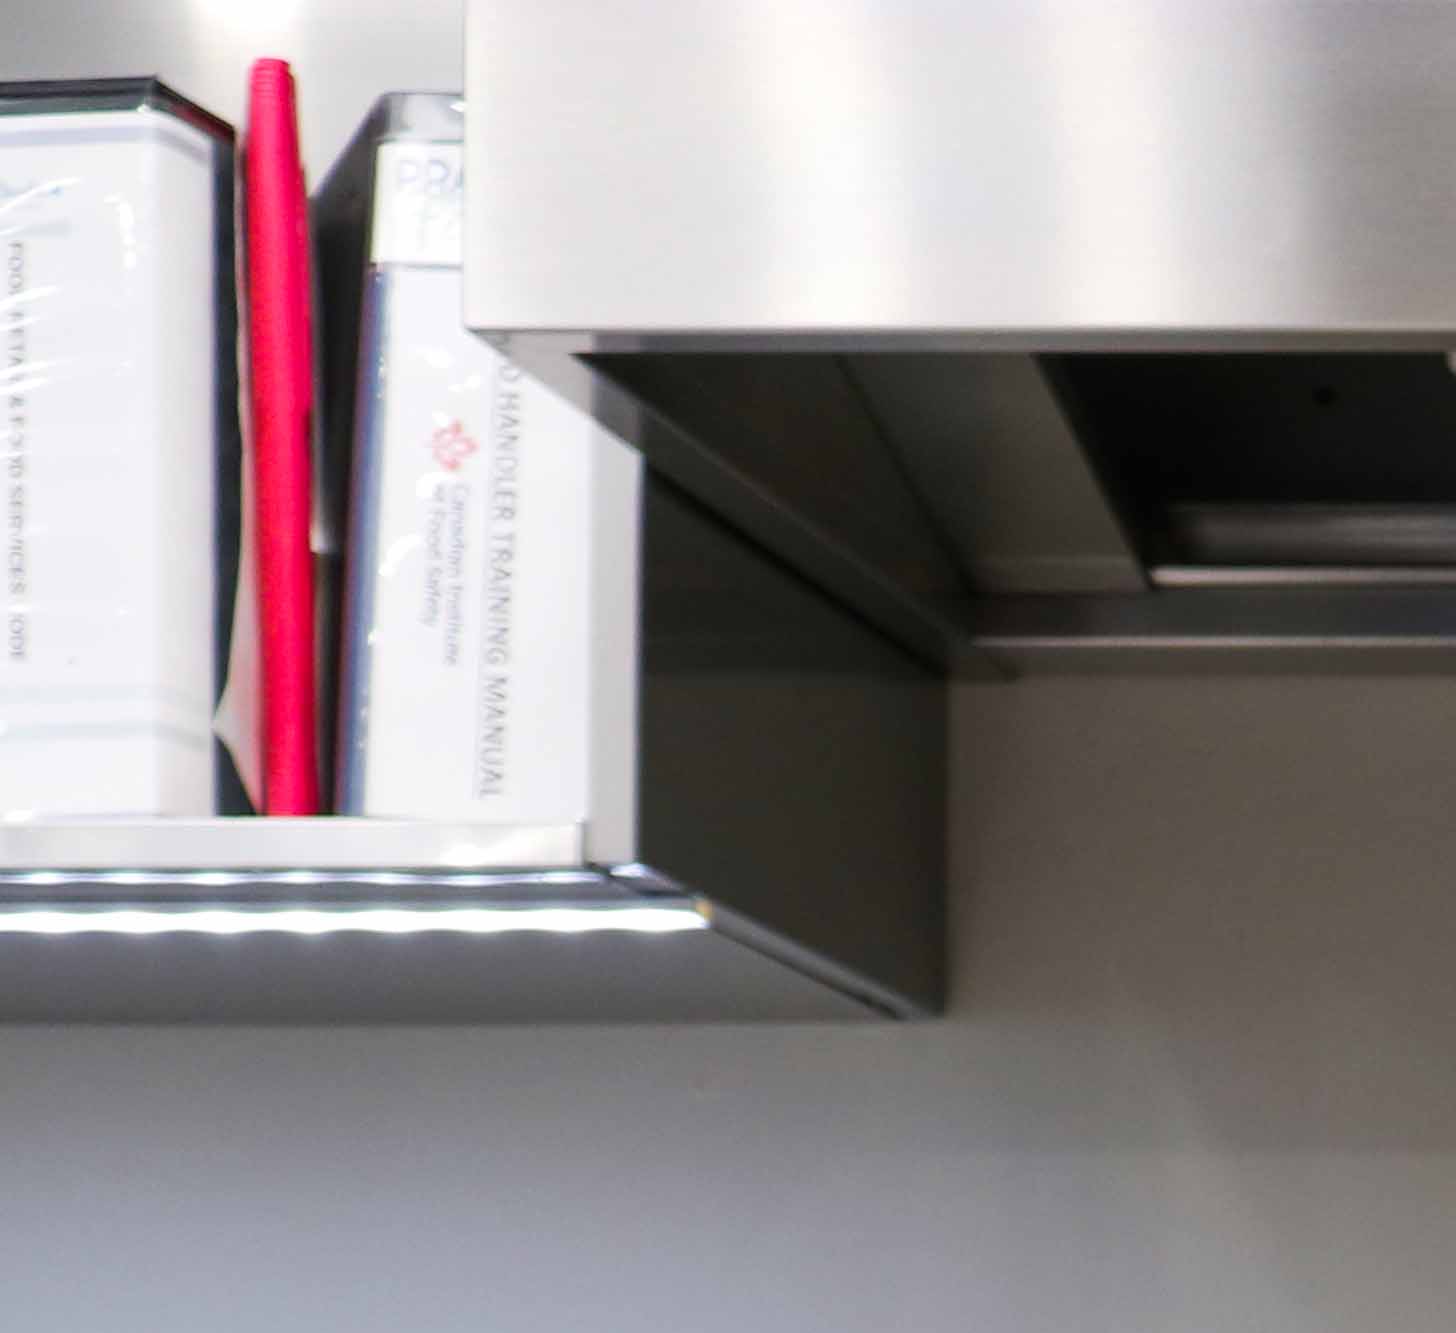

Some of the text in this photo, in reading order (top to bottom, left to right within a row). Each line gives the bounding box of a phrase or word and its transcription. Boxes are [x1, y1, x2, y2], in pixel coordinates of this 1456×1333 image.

[491, 393, 521, 521] HANDLER
[485, 532, 515, 665] TRAINING
[479, 674, 509, 799] MANUAL
